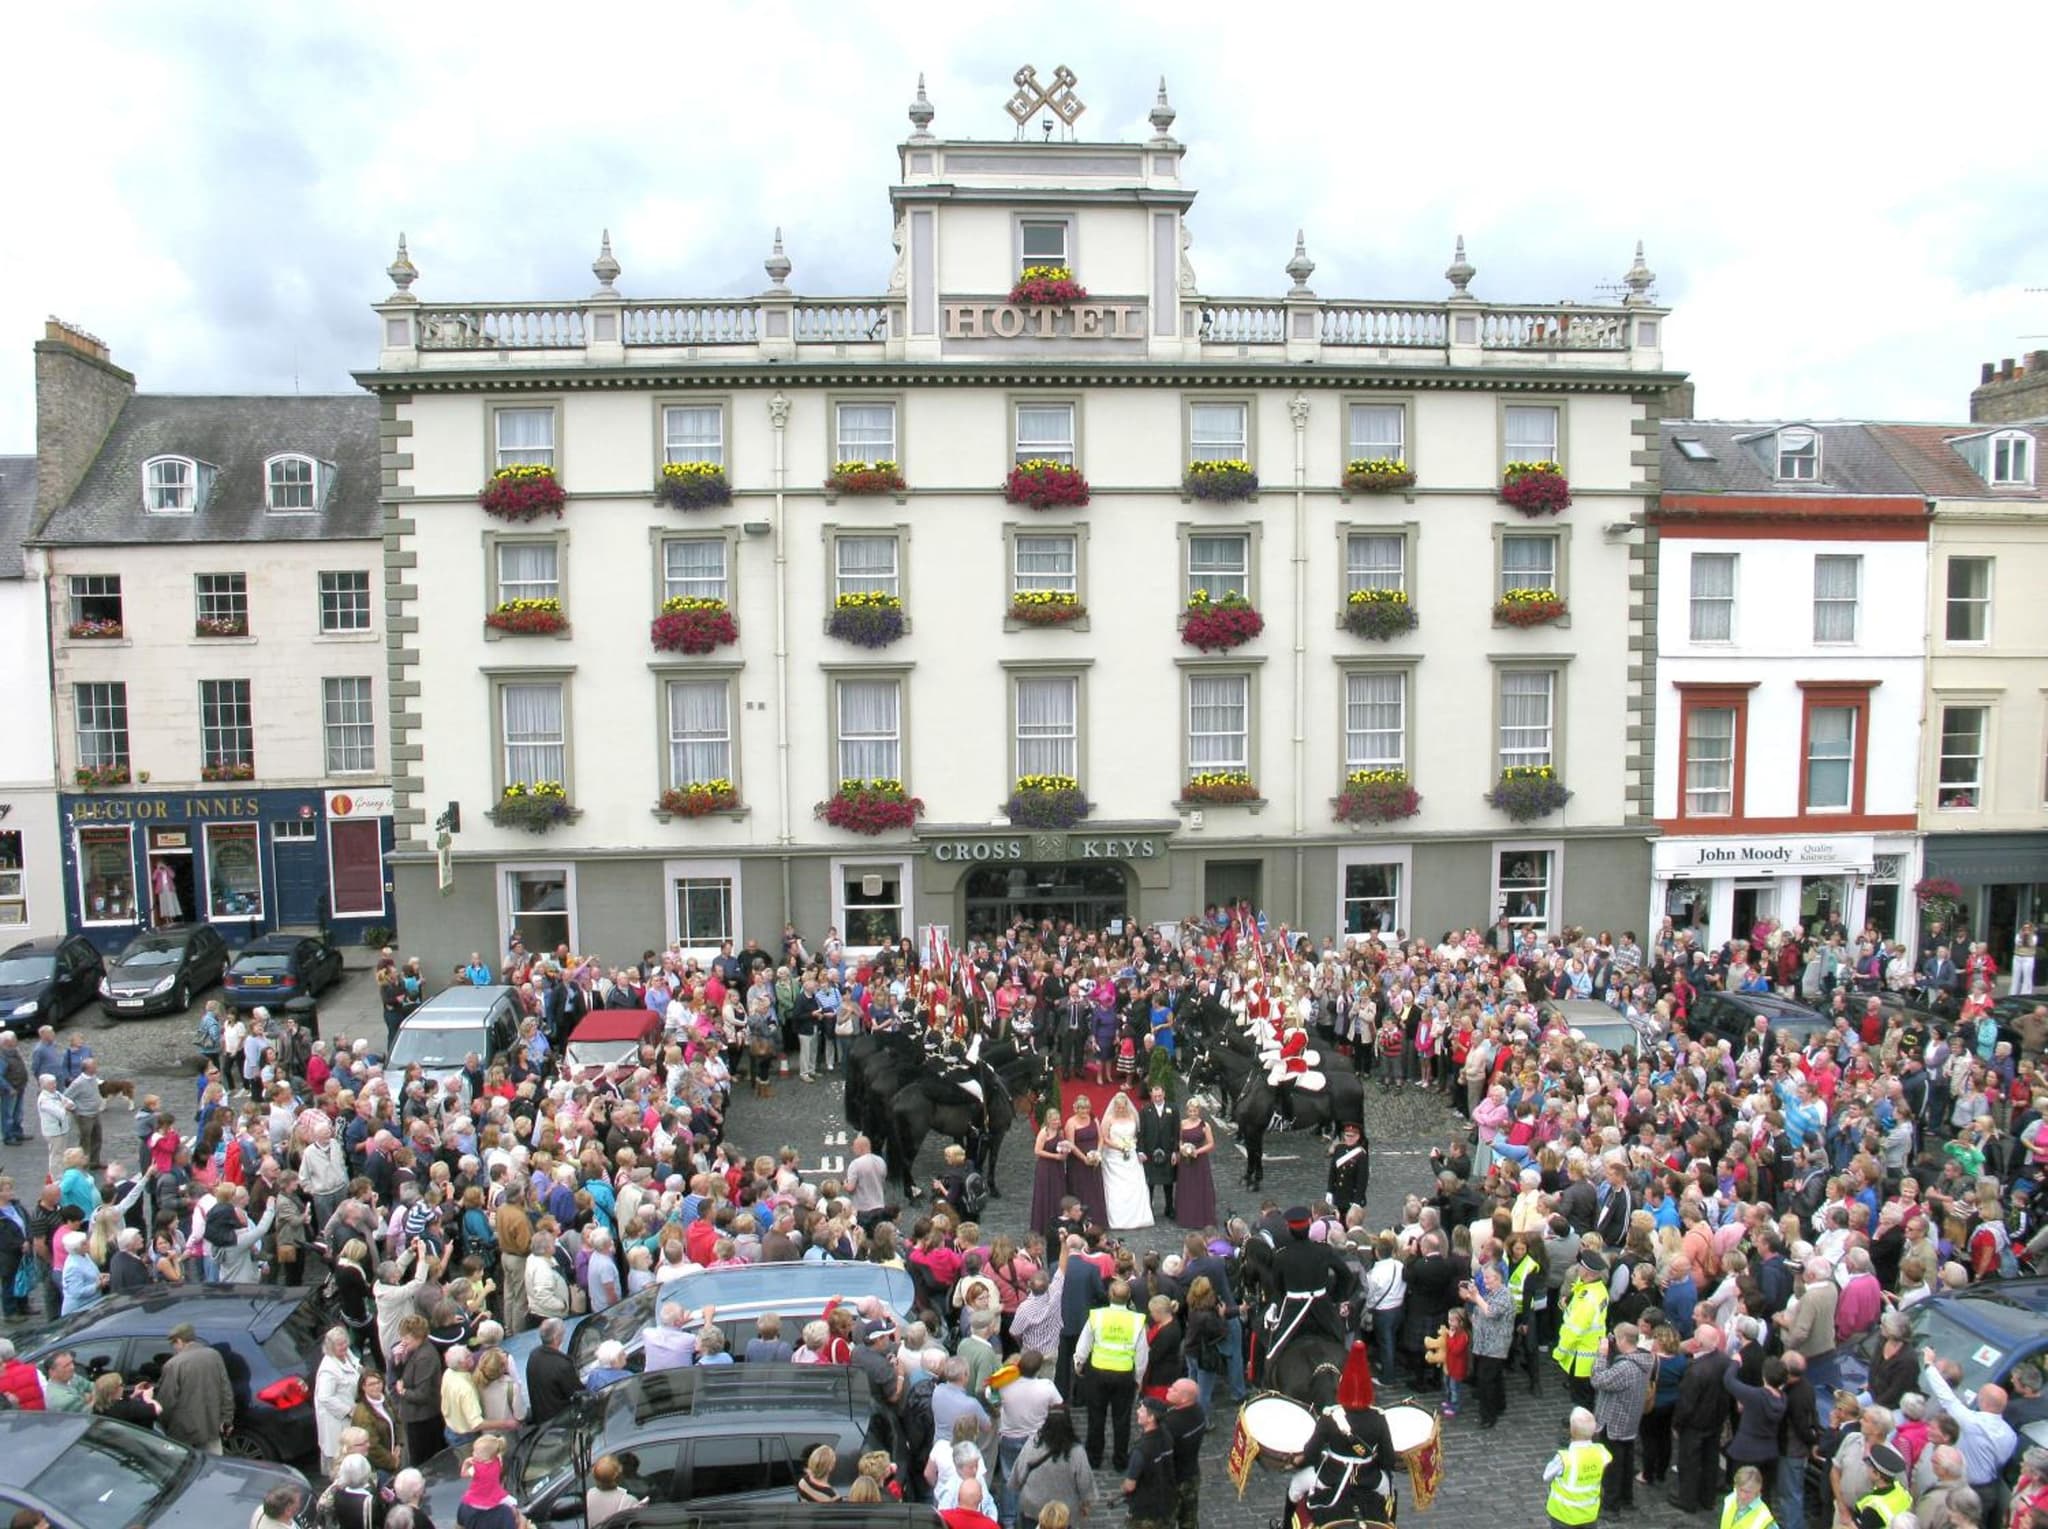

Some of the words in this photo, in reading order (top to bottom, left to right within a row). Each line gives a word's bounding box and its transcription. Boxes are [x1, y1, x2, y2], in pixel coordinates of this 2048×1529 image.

[943, 303, 1145, 338] HOTEL
[73, 800, 168, 820] HECTOR
[185, 797, 260, 818] INNES
[935, 840, 1022, 861] CROSS
[1083, 839, 1154, 858] KEYS
[1696, 847, 1736, 864] John
[1741, 845, 1793, 863] Moody
